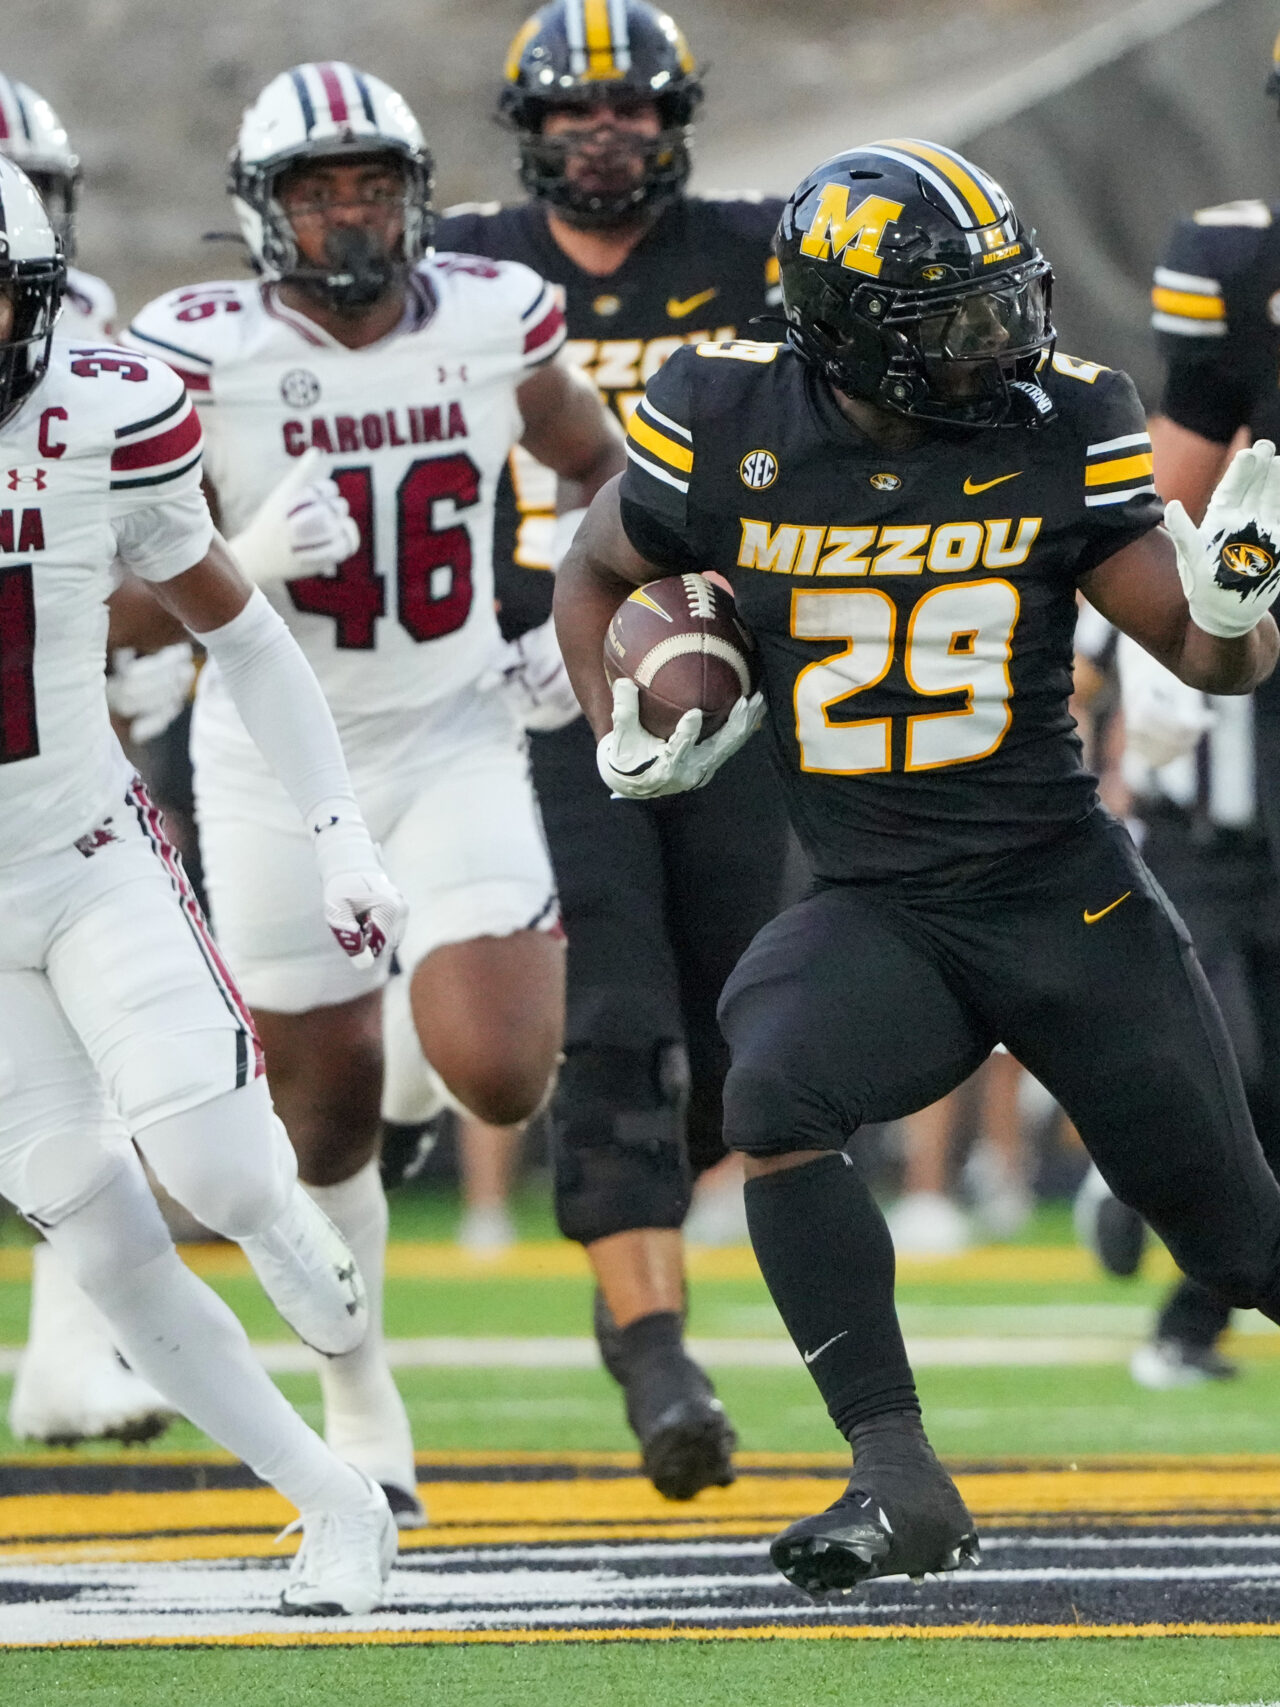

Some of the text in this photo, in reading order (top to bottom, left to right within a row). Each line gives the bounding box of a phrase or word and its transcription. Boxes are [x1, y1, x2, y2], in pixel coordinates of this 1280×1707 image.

[800, 182, 905, 278] M
[983, 243, 1021, 265] MIZZOU
[38, 407, 69, 459] C
[282, 401, 469, 457] CAROLINA
[740, 449, 779, 490] SEC
[286, 451, 483, 651] 46
[736, 516, 1042, 577] MIZZOU
[789, 576, 1021, 775] 29
